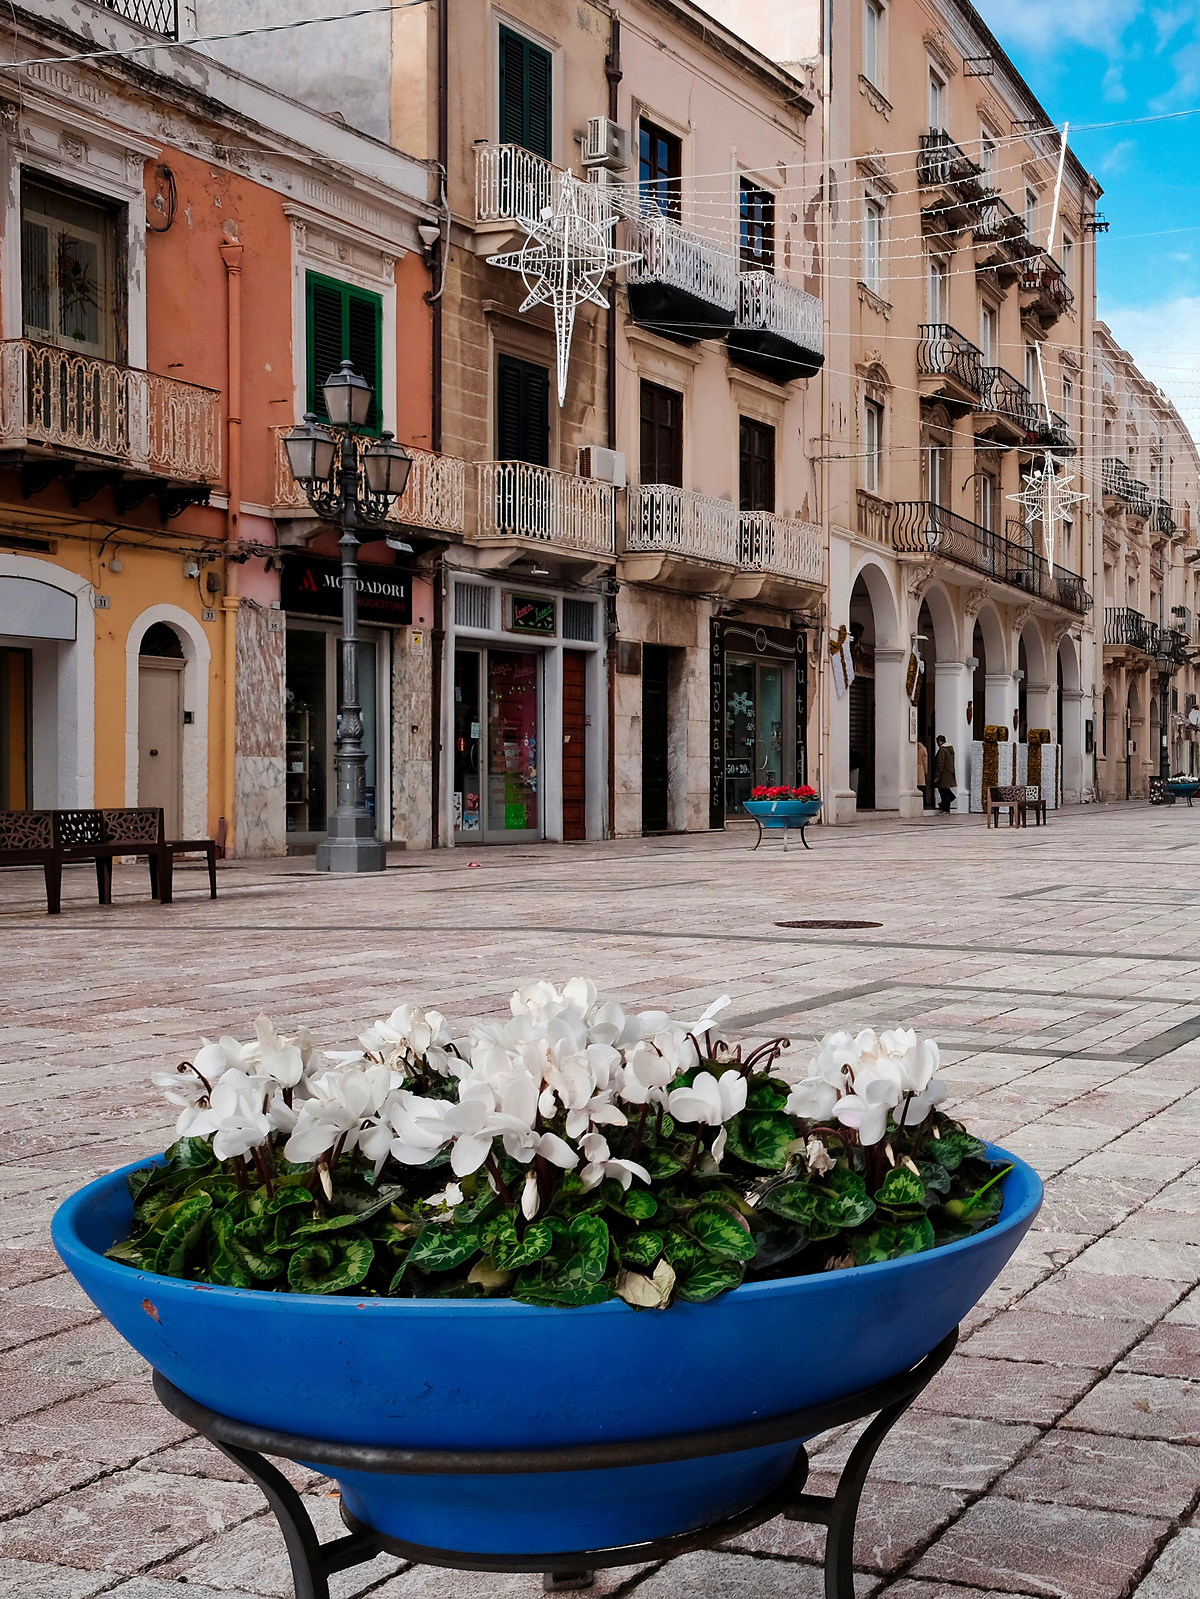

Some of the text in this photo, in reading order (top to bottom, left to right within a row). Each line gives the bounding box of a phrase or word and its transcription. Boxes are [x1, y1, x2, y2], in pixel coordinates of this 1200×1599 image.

[323, 574, 405, 598] MODADORI
[98, 598, 106, 607] 31
[357, 597, 406, 612] BOOKSTORE
[796, 634, 805, 774] Outle
